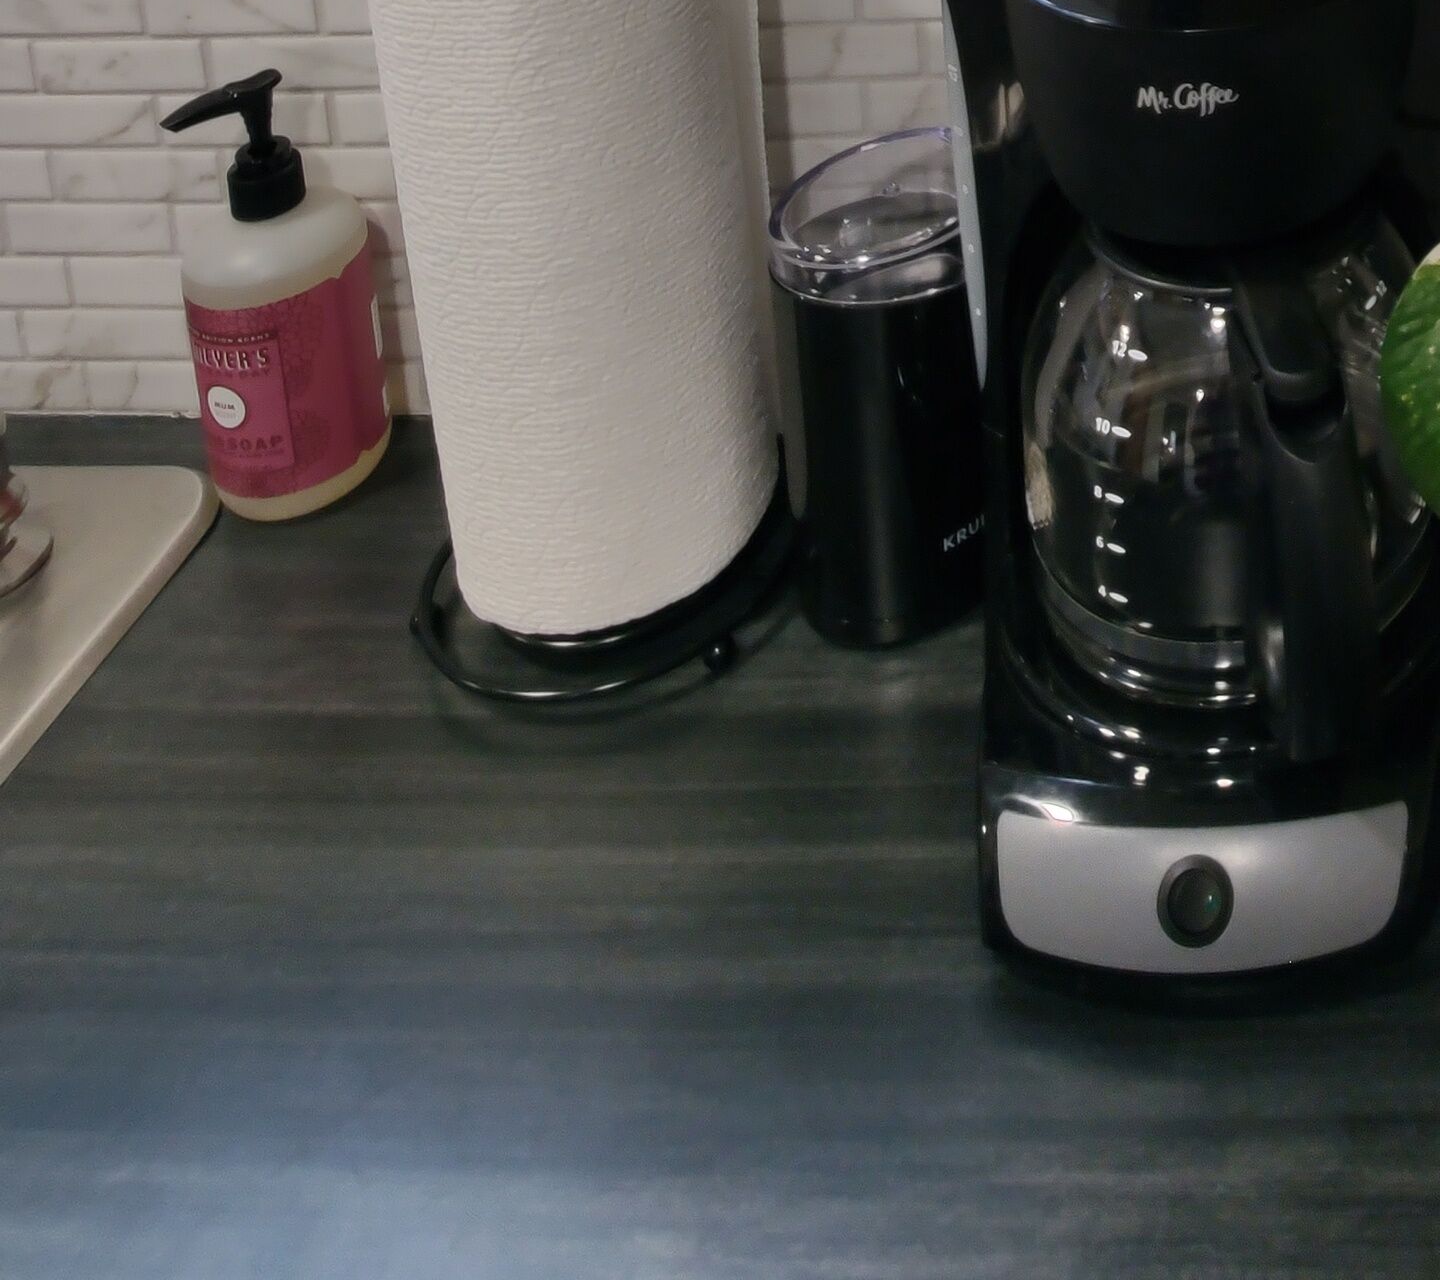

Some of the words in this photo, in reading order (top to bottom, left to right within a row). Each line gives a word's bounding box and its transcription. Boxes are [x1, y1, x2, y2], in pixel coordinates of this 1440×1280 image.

[1137, 86, 1172, 115] Mr.
[1174, 82, 1240, 117] Coffee
[1095, 417, 1110, 435] 10
[1095, 535, 1104, 549] 6
